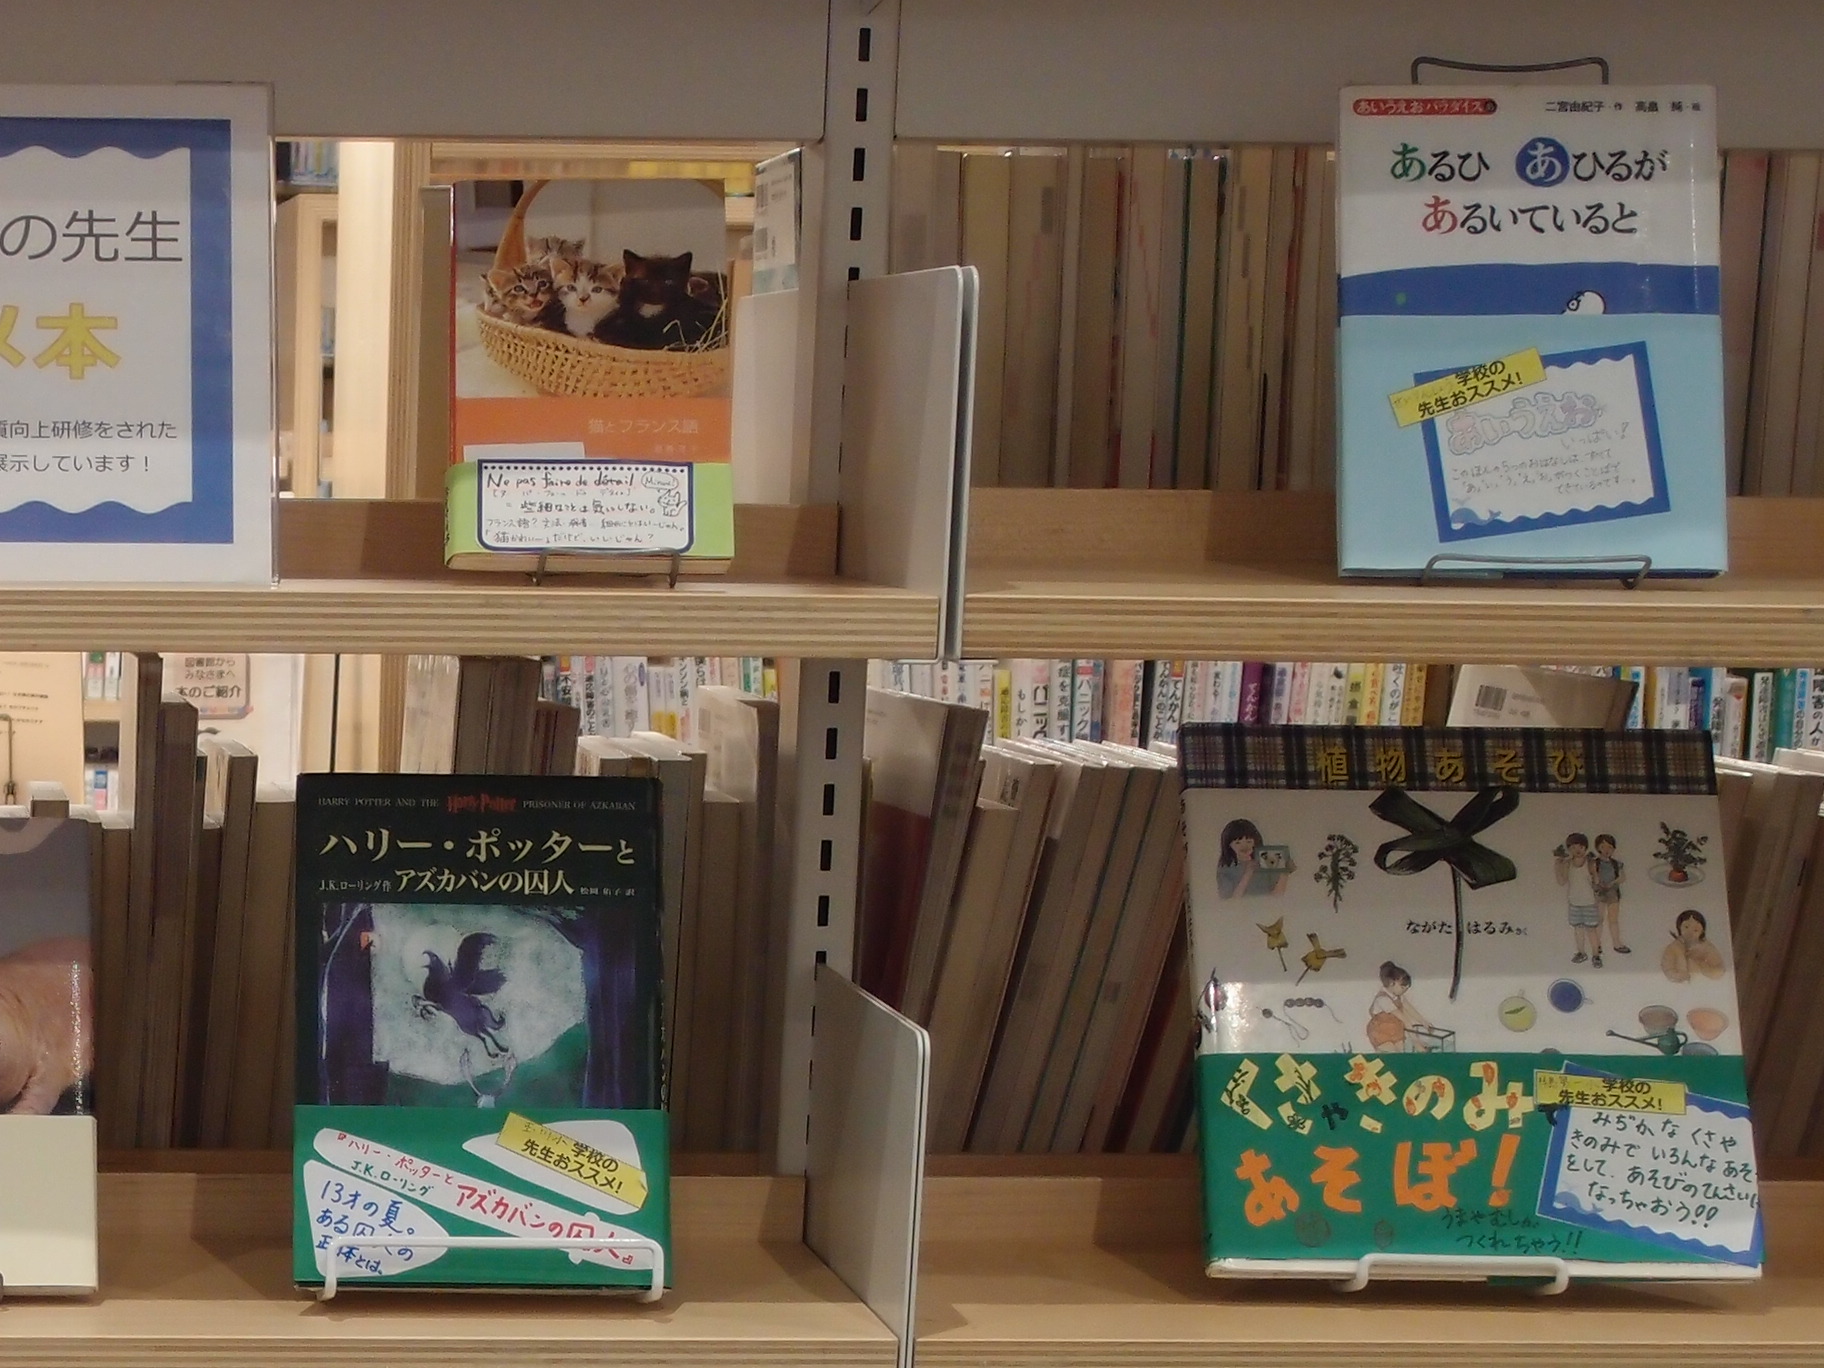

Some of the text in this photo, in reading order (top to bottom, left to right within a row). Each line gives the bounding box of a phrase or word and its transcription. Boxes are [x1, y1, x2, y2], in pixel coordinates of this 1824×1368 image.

[1390, 138, 1669, 183] あるひ あひるが
[1421, 195, 1638, 235] あるいていると
[1455, 360, 1505, 386] 学校の
[1417, 372, 1523, 418] 先生おススメ!
[487, 474, 509, 488] Ne
[516, 477, 536, 488] pas
[542, 472, 571, 489] faire
[576, 474, 588, 487] de
[1318, 747, 1585, 784] 植物あそび
[318, 797, 349, 806] HARRY
[354, 798, 391, 806] POTTER
[395, 798, 416, 806] AND
[421, 798, 439, 807] THE
[522, 799, 570, 810] PRISONER
[574, 800, 587, 810] OF
[590, 801, 636, 811] AZKABAN
[319, 828, 636, 865] ハリー・ポッターと
[394, 868, 574, 896] アズカバンの囚人
[1406, 920, 1515, 936] ながた はるみ
[1559, 1090, 1662, 1110] 先生おススメ!
[1602, 1078, 1651, 1094] 学校の
[1571, 1129, 1641, 1157] きのみで
[1691, 1128, 1737, 1152] くさや
[522, 1138, 624, 1195] 先生おススメ!
[571, 1141, 619, 1173] 学校の
[1235, 1134, 1520, 1227] あそぼ!
[320, 1180, 415, 1236] 13才の夏。
